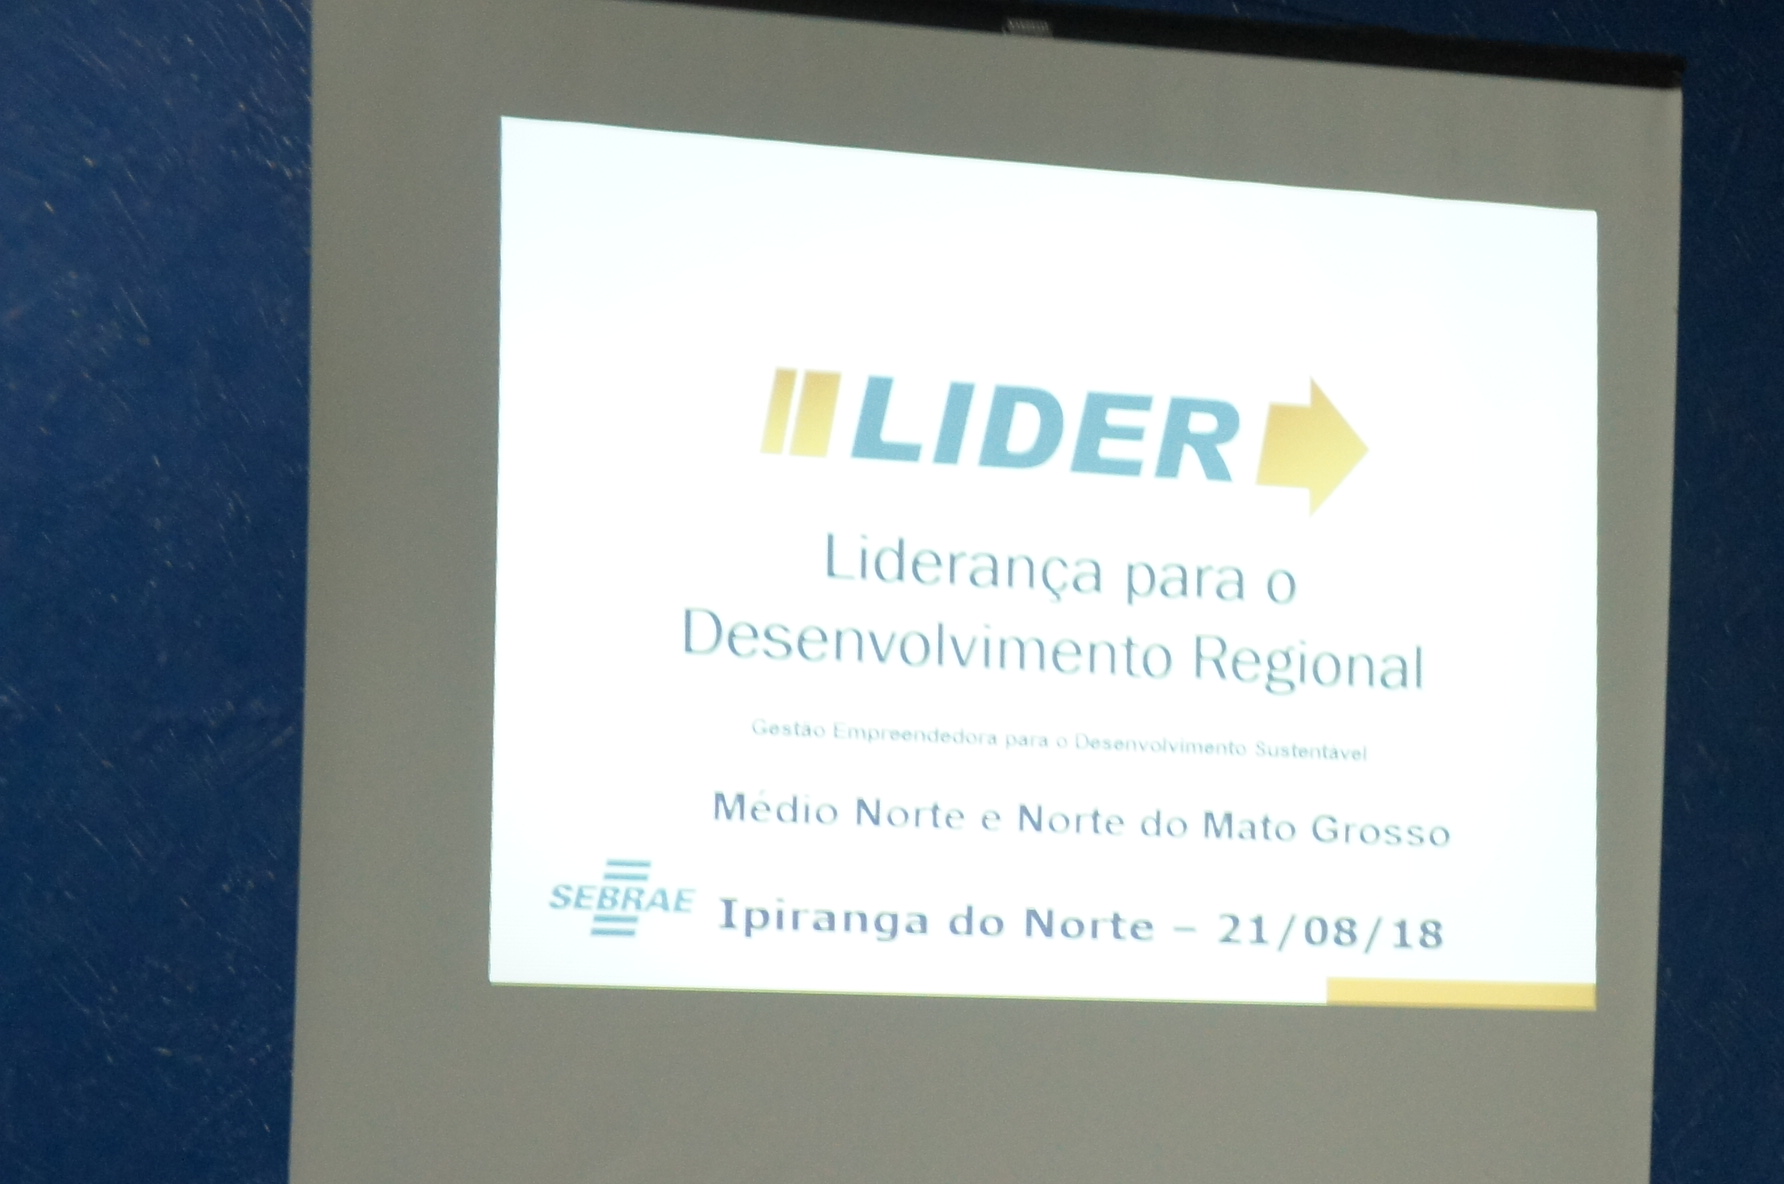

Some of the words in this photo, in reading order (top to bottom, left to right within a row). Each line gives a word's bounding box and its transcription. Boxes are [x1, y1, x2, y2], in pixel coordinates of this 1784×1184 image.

[850, 375, 1241, 483] LIDER
[825, 532, 1103, 601] Liderança
[1125, 560, 1246, 606] para
[1266, 569, 1297, 604] o
[683, 607, 1174, 679] Desenvolvimento
[1194, 634, 1423, 694] Regional
[752, 719, 827, 739] Gestão
[833, 722, 998, 748] Empreendedora
[1004, 733, 1050, 750] para
[1054, 735, 1069, 749] o
[1074, 733, 1247, 756] Desenvolvimento
[1255, 740, 1368, 762] Sustentável
[713, 790, 839, 825] Médio
[855, 797, 966, 829] Norte
[980, 808, 1003, 831] e
[1018, 803, 1125, 835] Norte
[1139, 809, 1189, 838] do
[1203, 810, 1297, 841] Mato
[1310, 814, 1452, 848] Grosso
[548, 883, 694, 914] SEBRAE
[721, 897, 929, 942] Ipiranga
[948, 904, 1005, 937] do
[1025, 907, 1154, 942] Norte
[1219, 913, 1444, 954] 21/08/18
